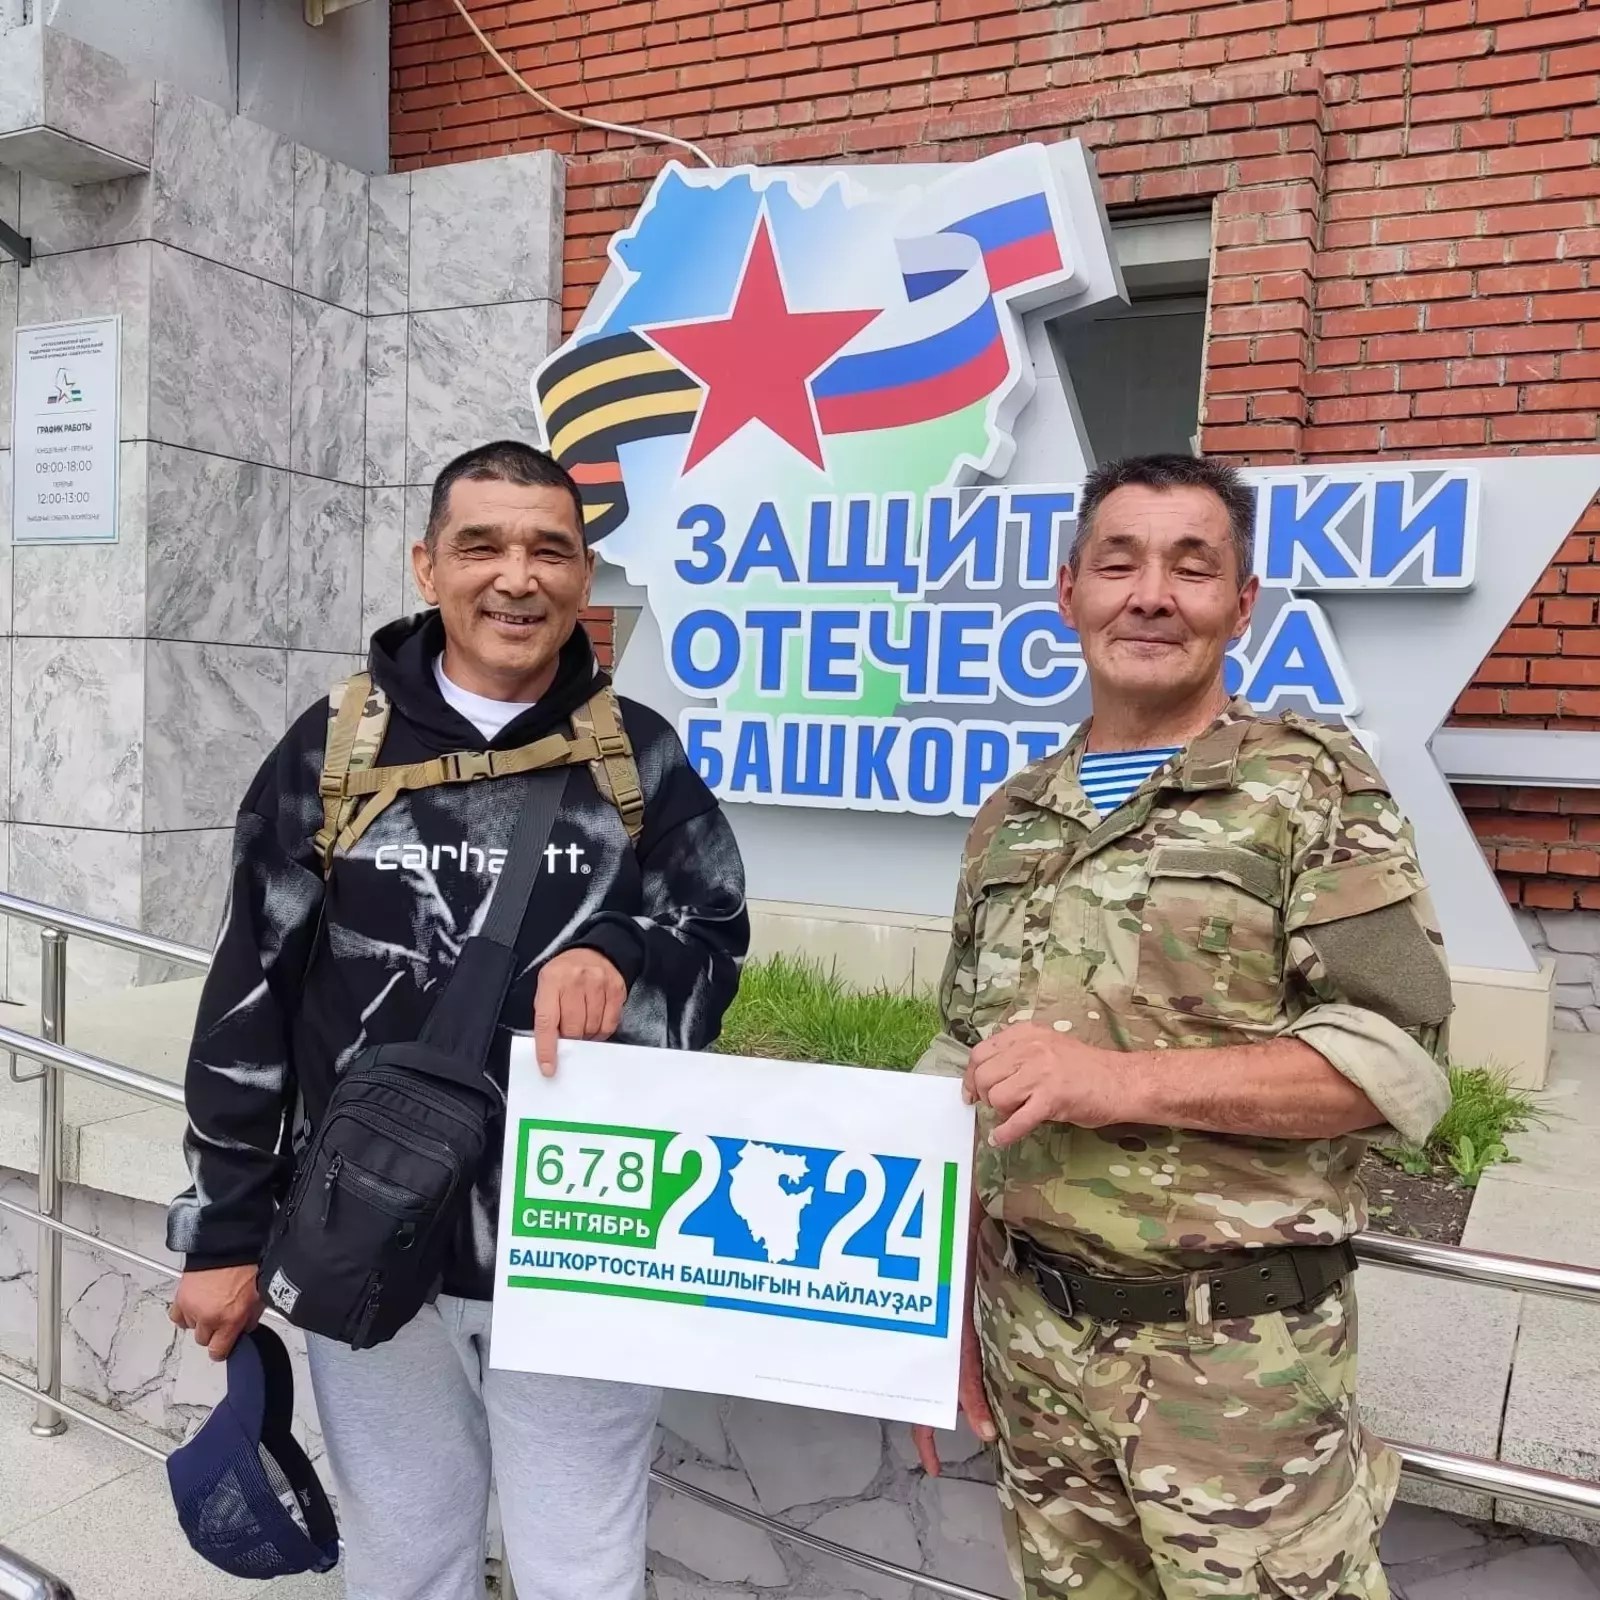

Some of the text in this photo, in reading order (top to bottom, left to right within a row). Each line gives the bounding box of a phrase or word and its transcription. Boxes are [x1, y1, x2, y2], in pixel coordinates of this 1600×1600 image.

[36, 422, 92, 434] ГРАФИК РАБОТЫ
[35, 460, 93, 474] 09:00-18:00
[37, 492, 91, 504] 12:00-13:00
[674, 478, 1468, 594] ЗАЩИТКИ
[671, 608, 1346, 706] ОТЕЧЕСА
[686, 718, 1060, 807] БАШКОРТ
[375, 841, 585, 874] carhatt
[536, 1144, 644, 1197] 6,7,8
[522, 1208, 651, 1238] СЕНТЯБРЬ
